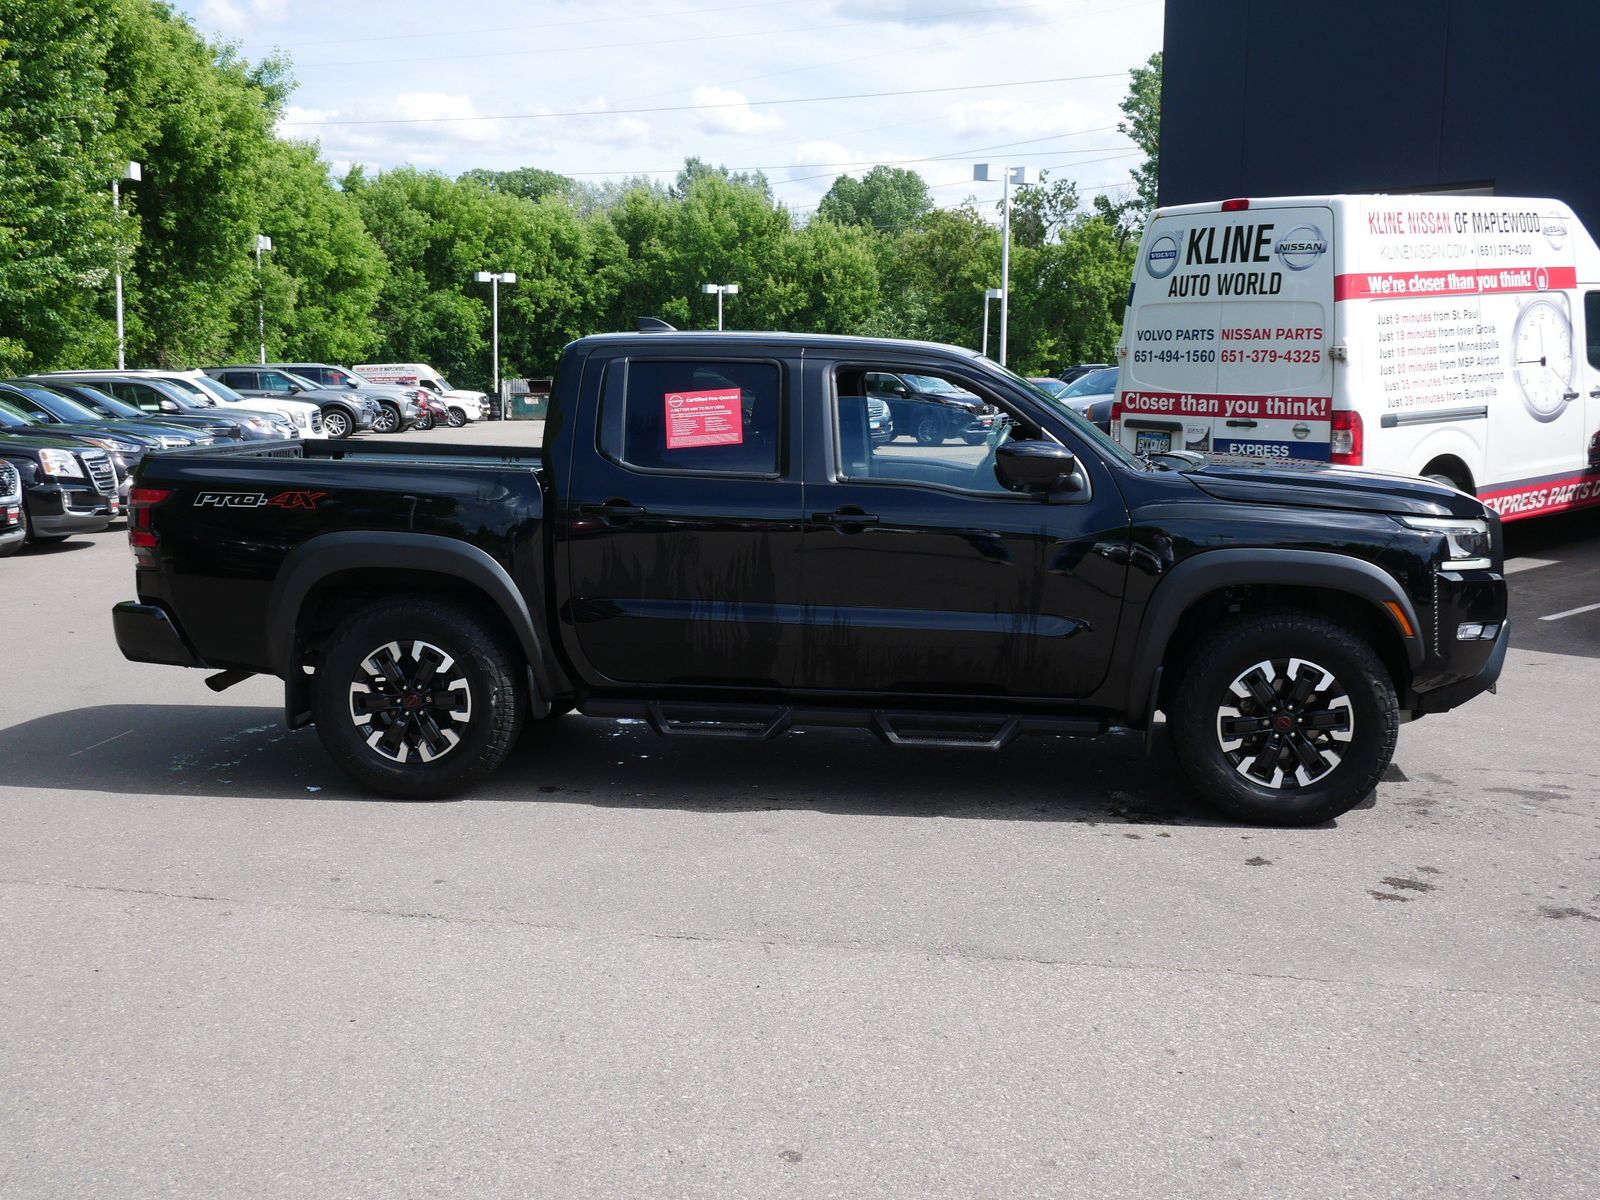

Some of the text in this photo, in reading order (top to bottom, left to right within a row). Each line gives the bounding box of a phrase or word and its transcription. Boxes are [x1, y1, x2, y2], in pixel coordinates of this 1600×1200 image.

[1368, 212, 1540, 234] KLINE NISSAN OF MAPLEWOOD
[1186, 224, 1274, 265] KLINE
[1478, 245, 1496, 257] (651)
[1168, 272, 1282, 297] AUTO WORLD
[1368, 270, 1530, 293] We're closer than you think!
[1378, 309, 1478, 324] Just 9 minutes from St. Paul
[1138, 329, 1214, 341] VOLVO PARTS
[1222, 328, 1323, 340] NISSAN PARTS
[1379, 325, 1496, 342] Just 19 minutes from Inver Grove
[1135, 350, 1215, 362] 651-494-1560
[1221, 350, 1320, 363] 651-379-4325
[1380, 340, 1499, 358] Just 19 minutes from Minneapolis
[1380, 356, 1499, 375] Just 20 minutes from MSP Airport
[1385, 382, 1400, 391] Just
[1412, 378, 1441, 388] minutes
[1443, 376, 1458, 384] from
[1462, 372, 1504, 383] Bloomington
[1125, 393, 1326, 416] Closer than you think!
[1388, 398, 1402, 408] Just
[1416, 394, 1445, 404] minutes
[1447, 392, 1462, 401] from
[1230, 444, 1289, 457] EXPRESS
[1484, 490, 1547, 515] EXPRESS
[1548, 481, 1591, 505] PARTS
